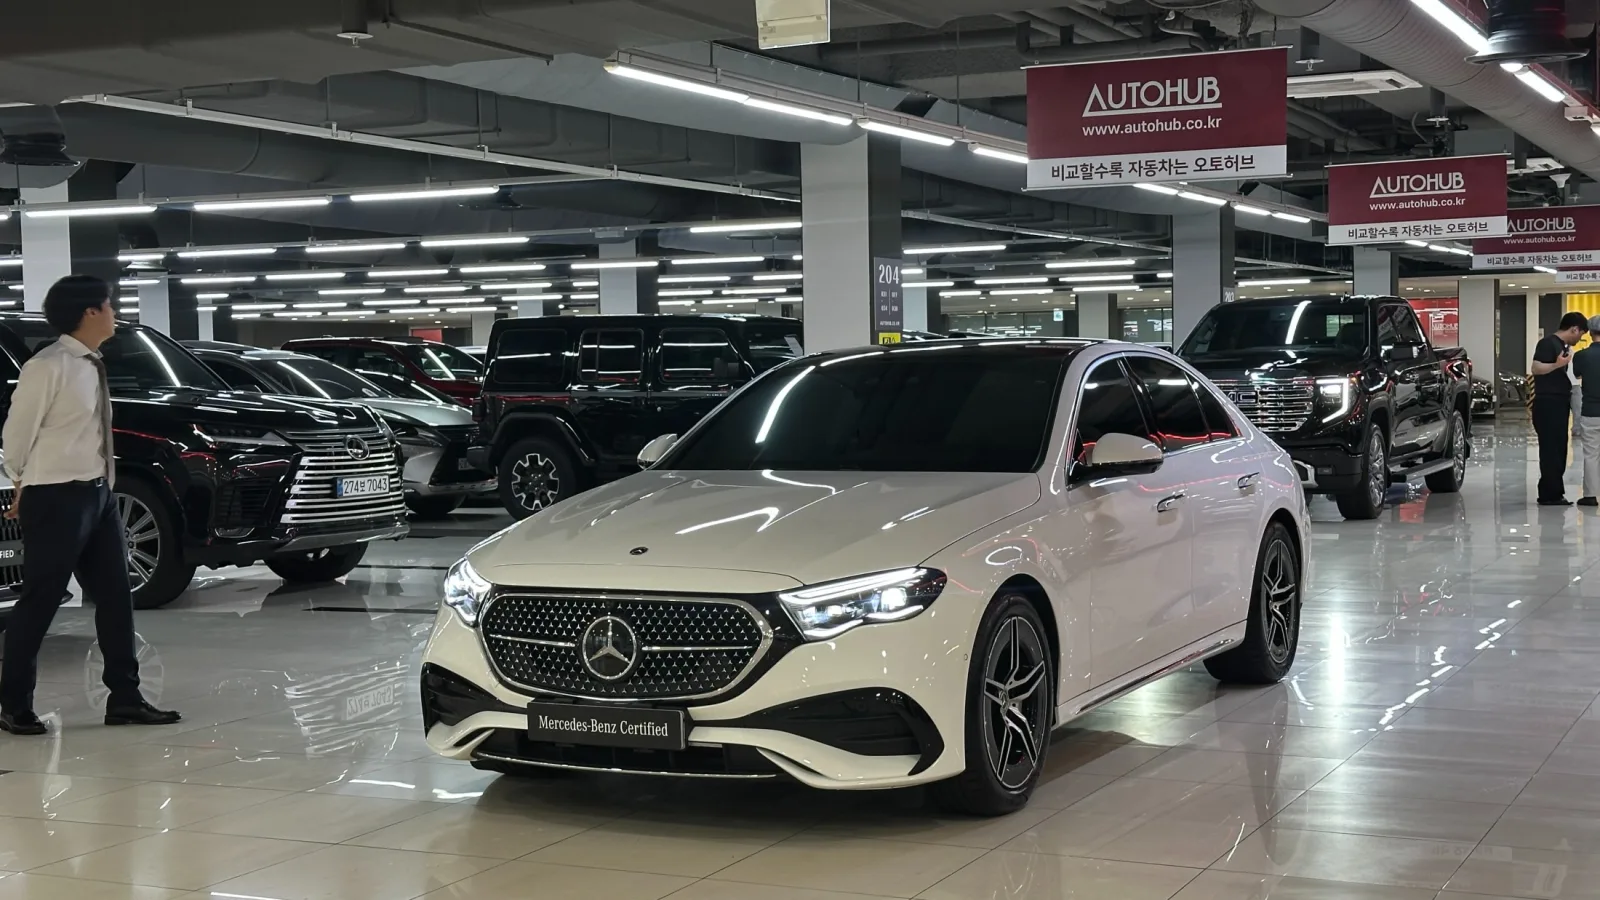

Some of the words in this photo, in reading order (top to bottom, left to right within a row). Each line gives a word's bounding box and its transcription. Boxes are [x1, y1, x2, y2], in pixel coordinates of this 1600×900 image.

[1082, 76, 1222, 117] AUTOHUB
[1082, 115, 1222, 137] www.autohub.co.kr
[1051, 160, 1124, 181] 비교할수록
[1128, 158, 1189, 178] 자동차는
[1193, 154, 1255, 174] 오토허브
[1369, 172, 1466, 198] AUTOHUB
[1369, 197, 1466, 211] www.autohub.co.kr
[1348, 224, 1399, 239] 비교할수록
[1401, 222, 1443, 237] 자동차는
[1446, 221, 1489, 234] 오토허브
[1507, 217, 1576, 235] AUTOHUB
[1503, 235, 1576, 245] www.autohub.co.kr
[1487, 256, 1525, 265] 비교할수록
[1527, 254, 1559, 264] 자동차는
[1561, 253, 1593, 263] 오토허브
[879, 264, 900, 285] 204
[538, 715, 617, 735] Mercedes-Benz
[620, 720, 669, 737] Certified
